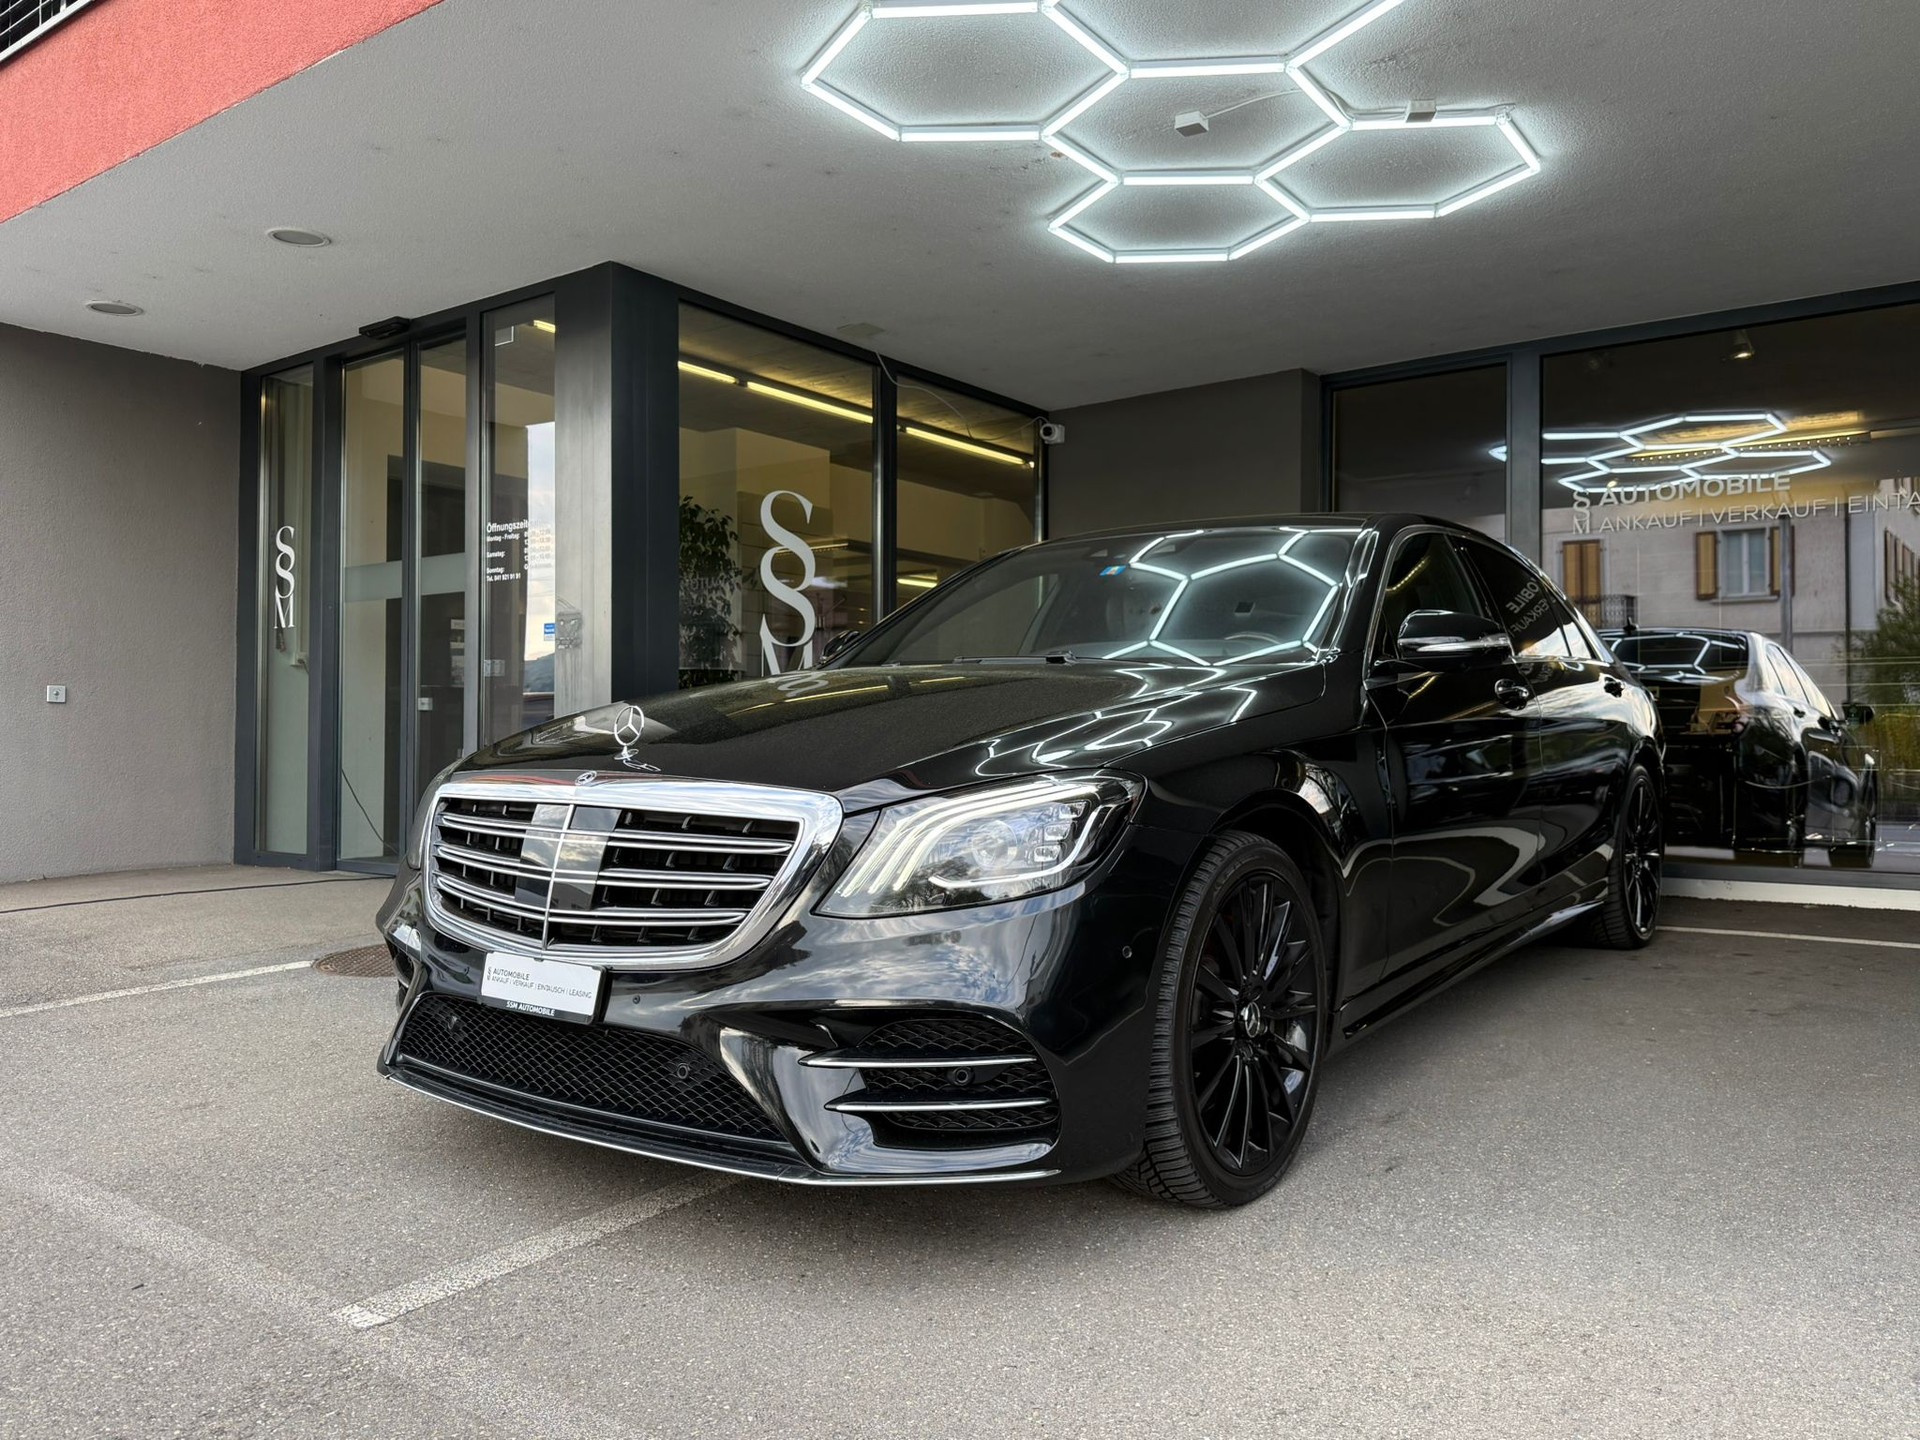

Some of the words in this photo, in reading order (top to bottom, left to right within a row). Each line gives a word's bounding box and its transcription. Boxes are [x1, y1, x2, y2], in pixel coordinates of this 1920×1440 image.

[1599, 473, 1791, 506] AUTOMOBILE
[1599, 509, 1693, 532] ANKAUF
[1711, 498, 1826, 524] VERKAUF
[487, 519, 540, 533] Öffnungszeit
[493, 968, 530, 981] AUTOMOBILE
[512, 979, 534, 989] VERKAUF
[537, 984, 565, 994] EINTAUSCH
[569, 989, 592, 999] LEASING
[506, 1000, 518, 1009] SSM
[518, 1004, 555, 1016] AUTOMOBILE
